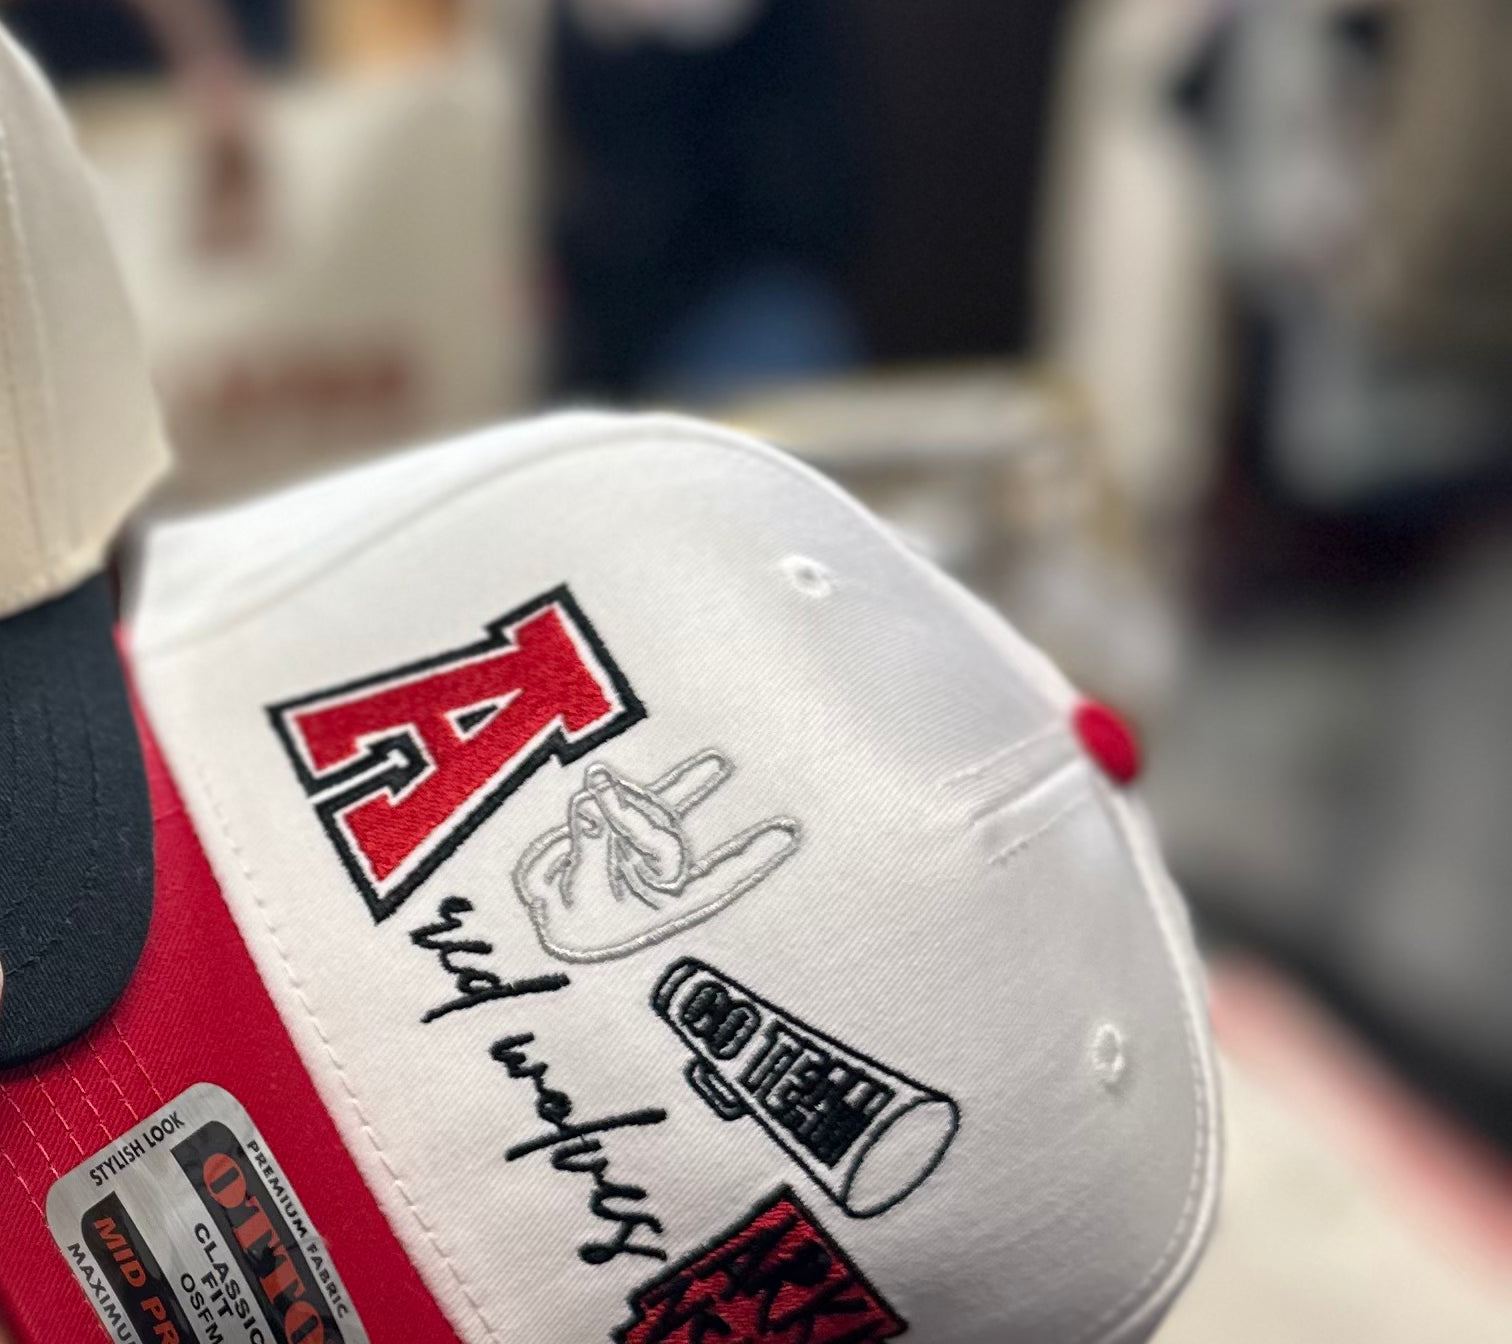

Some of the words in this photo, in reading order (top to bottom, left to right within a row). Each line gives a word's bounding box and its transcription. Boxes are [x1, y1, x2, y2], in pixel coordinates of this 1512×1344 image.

[264, 582, 648, 926] A
[409, 896, 570, 1024] red
[89, 1138, 146, 1188] STYLISH
[142, 1111, 186, 1149] LOOK
[489, 1032, 668, 1265] wolves
[93, 1216, 146, 1288] MID
[246, 1140, 308, 1239] PREMIUM
[306, 1242, 349, 1319] FABRIC
[200, 1270, 234, 1319] FIT
